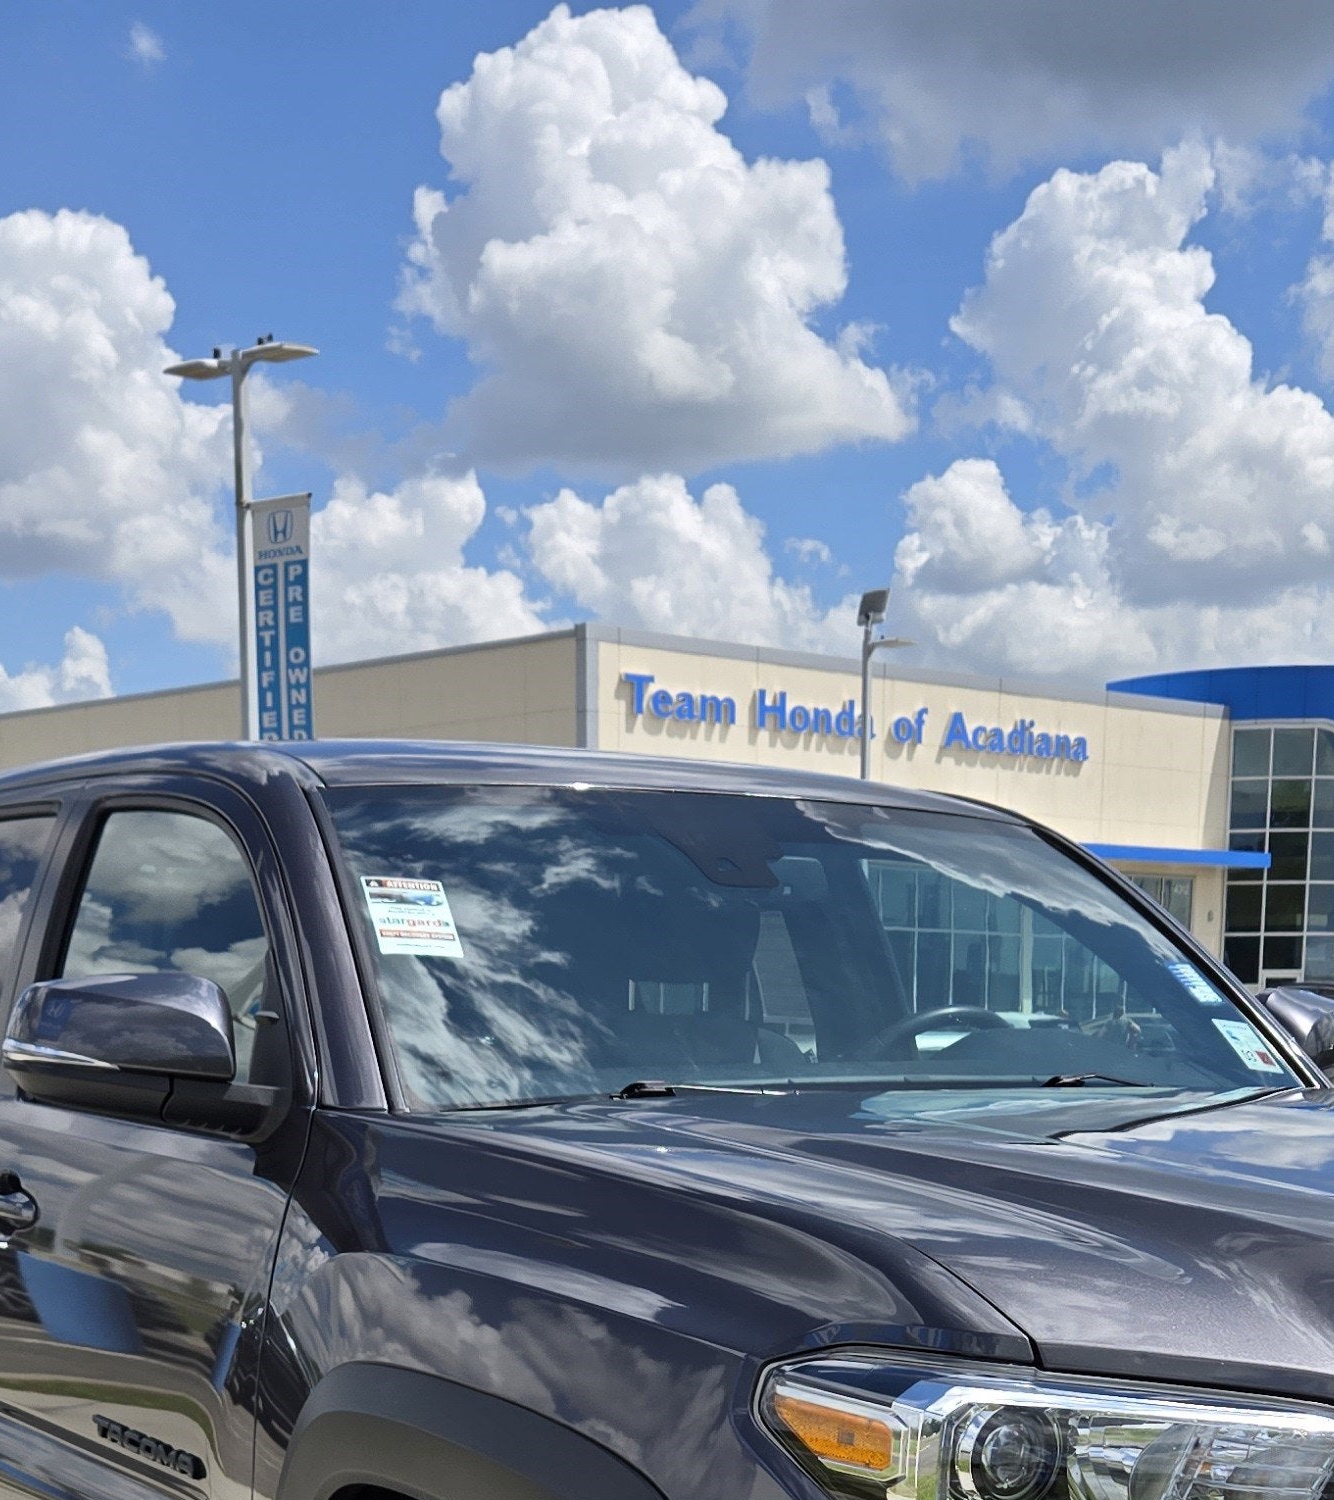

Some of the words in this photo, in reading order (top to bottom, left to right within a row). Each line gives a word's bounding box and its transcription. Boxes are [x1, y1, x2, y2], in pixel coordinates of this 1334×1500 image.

[257, 545, 304, 561] HONDA
[288, 564, 303, 623] PRE
[624, 673, 736, 725] Team
[757, 688, 876, 740] Honda
[893, 706, 929, 744] of
[944, 711, 1089, 763] Acadiana
[92, 1414, 207, 1480] TACOMA
